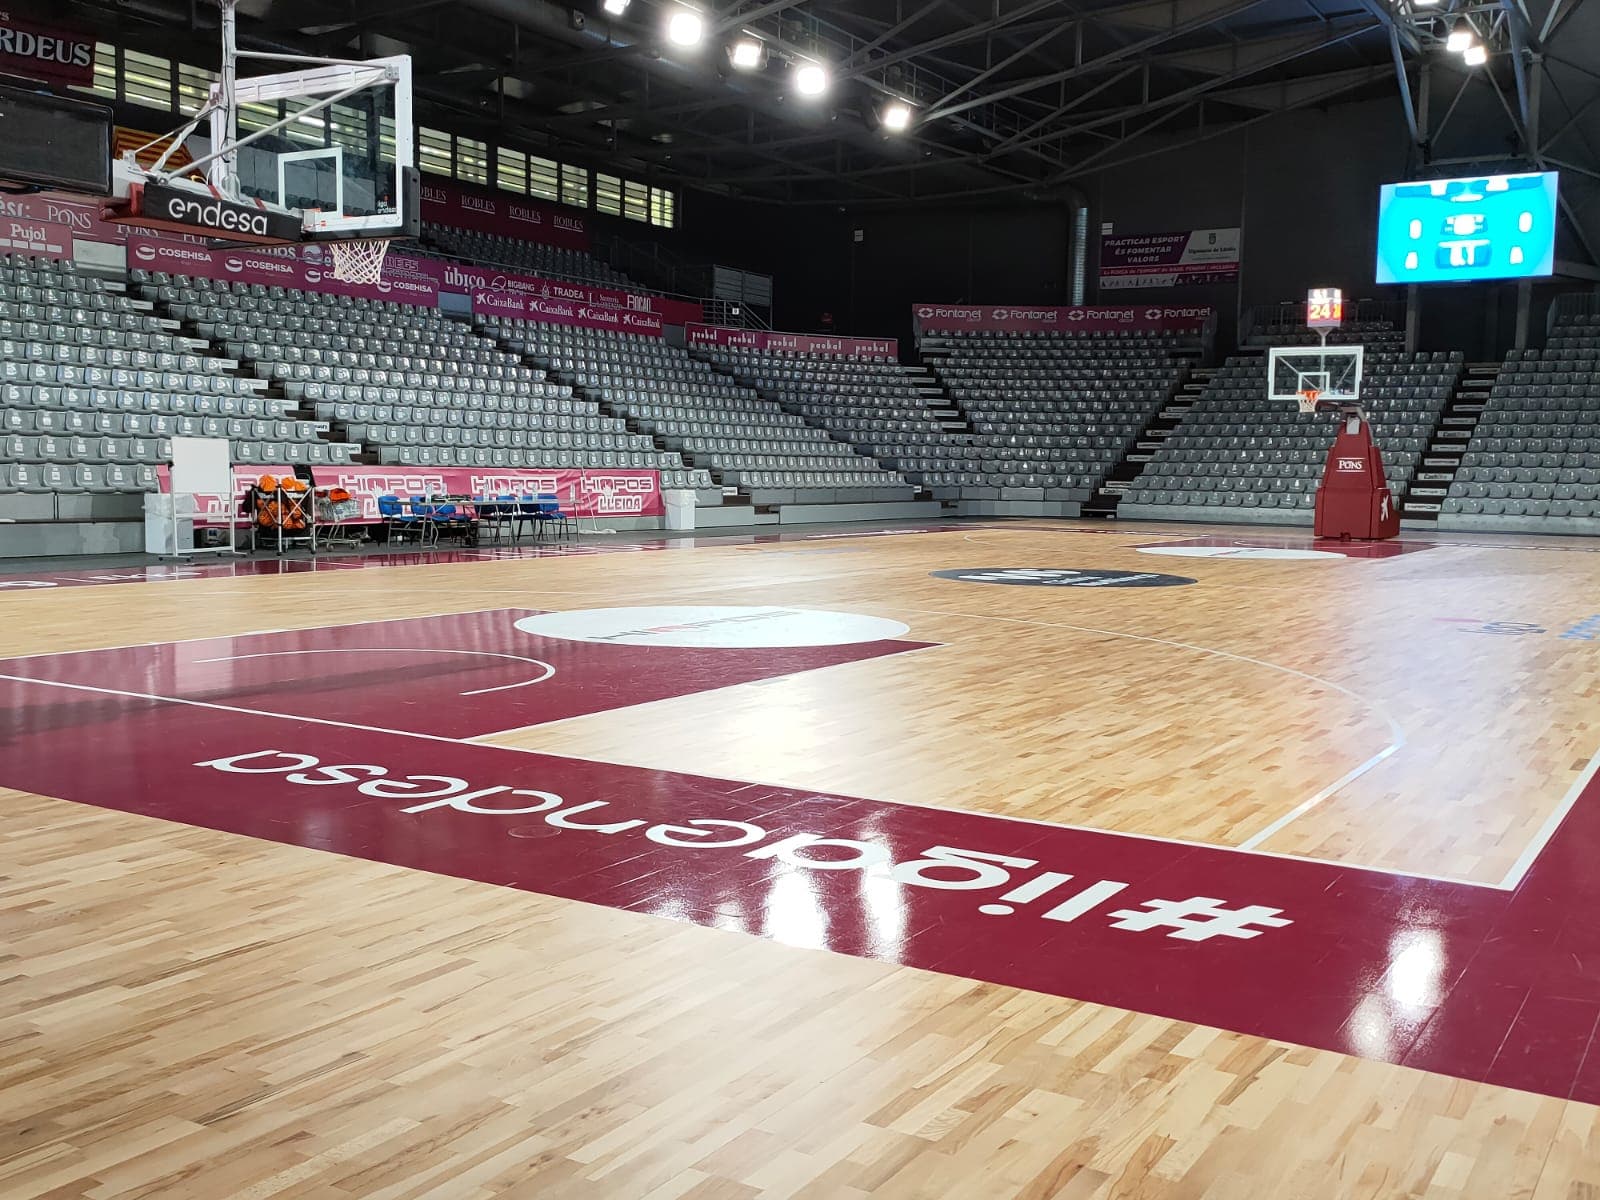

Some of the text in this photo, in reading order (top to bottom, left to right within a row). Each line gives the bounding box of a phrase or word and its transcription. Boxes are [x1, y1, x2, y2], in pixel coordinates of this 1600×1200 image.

[0, 27, 91, 66] RDEUS
[420, 186, 447, 201] BLES
[461, 194, 495, 211] ROBLES
[47, 205, 92, 230] PONS
[168, 198, 268, 235] endesa
[509, 205, 541, 221] ROBLES
[553, 215, 583, 230] ROBLES
[10, 223, 46, 241] Pujol
[1104, 235, 1185, 247] PRACTICAR ESPORT
[158, 247, 213, 263] COSEHISA
[1127, 246, 1172, 254] FOMENTAR
[245, 259, 294, 274] COSEHISA
[393, 281, 433, 293] COSEHISA
[553, 286, 584, 300] TRADEA
[487, 294, 525, 310] CaixaBank
[539, 301, 574, 317] CaixaBank
[587, 308, 619, 323] CaixaBank
[936, 308, 982, 319] Fontanet
[1011, 310, 1058, 320] Fontanet
[1086, 310, 1134, 320] Fontanet
[1164, 307, 1211, 319] Fontanet
[631, 314, 661, 329] CaixaBank
[1338, 460, 1363, 470] PONS
[597, 495, 642, 513] LLEIDA
[193, 750, 1294, 942] #ligaendesa
